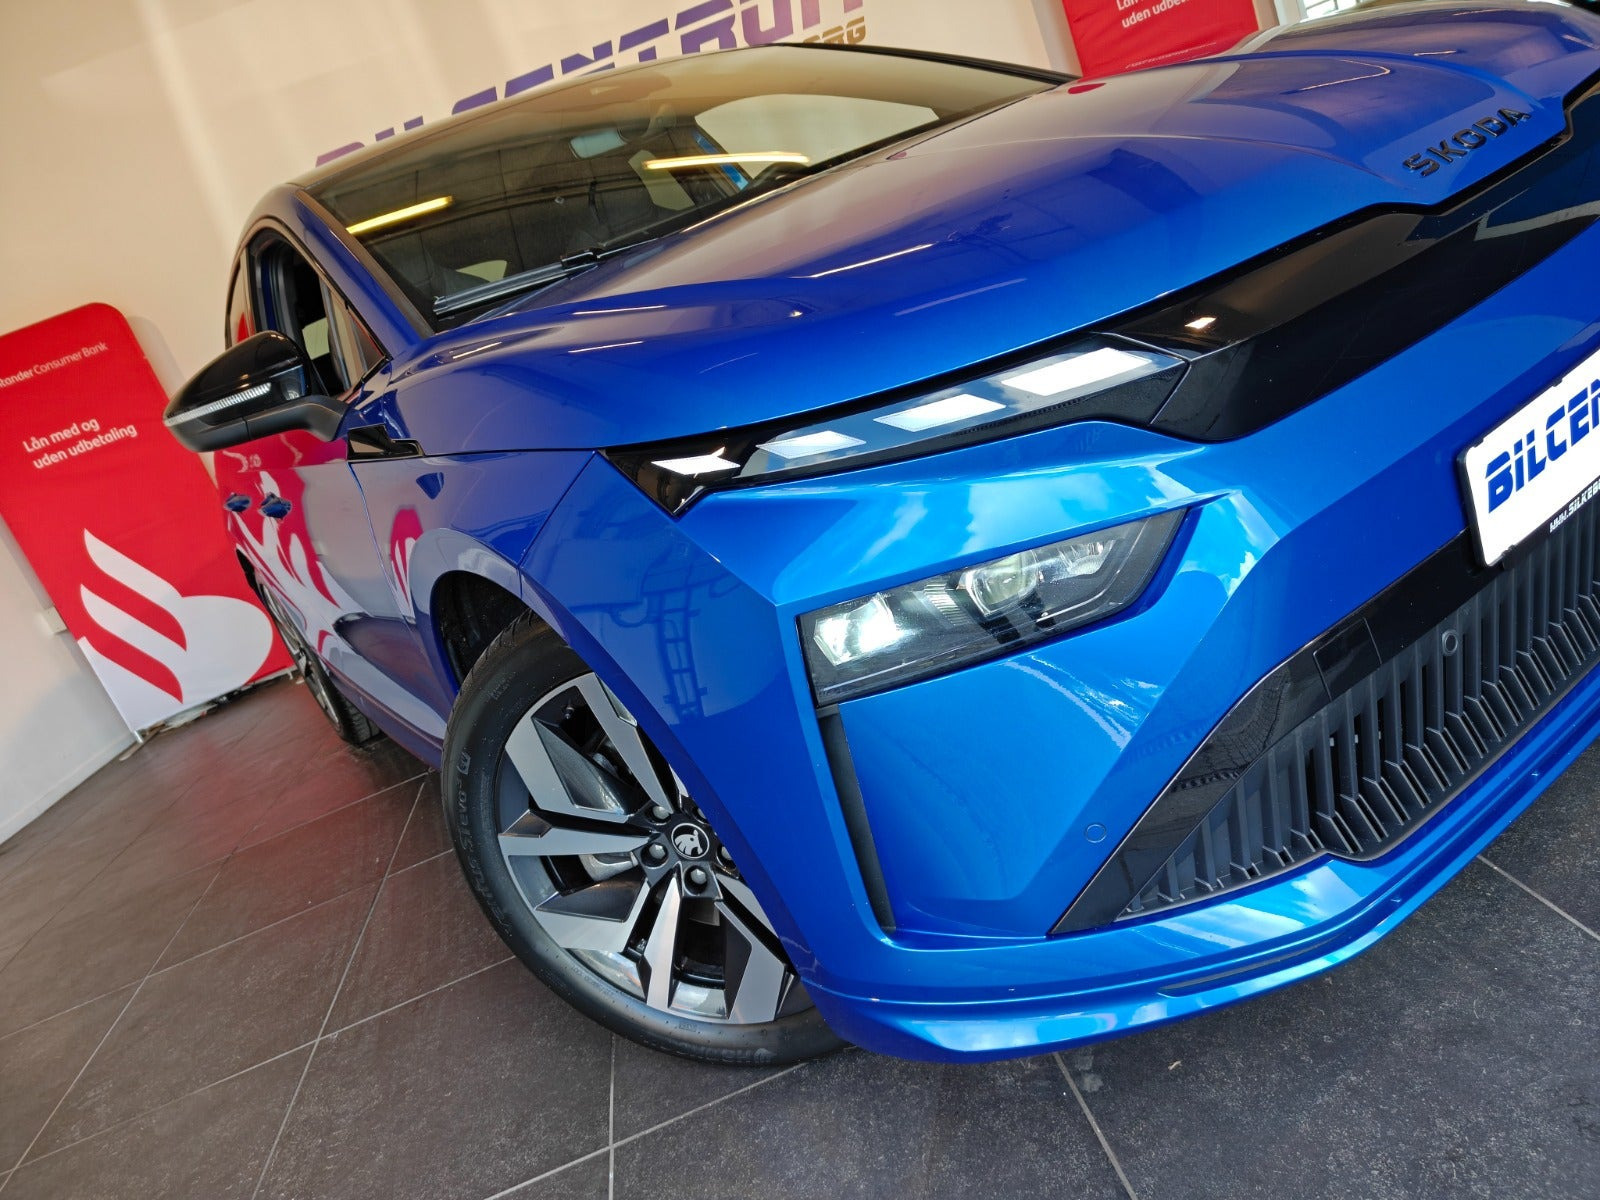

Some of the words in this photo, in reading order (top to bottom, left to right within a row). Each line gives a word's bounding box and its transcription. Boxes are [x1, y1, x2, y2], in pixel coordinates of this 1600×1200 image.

[1122, 9, 1151, 28] uden
[0, 370, 33, 388] tander
[33, 351, 81, 375] Consumer
[81, 342, 108, 357] Bank
[22, 436, 50, 452] Lån
[50, 423, 80, 443] med
[81, 418, 100, 431] og
[33, 450, 68, 469] uden
[68, 424, 138, 456] udbetaling
